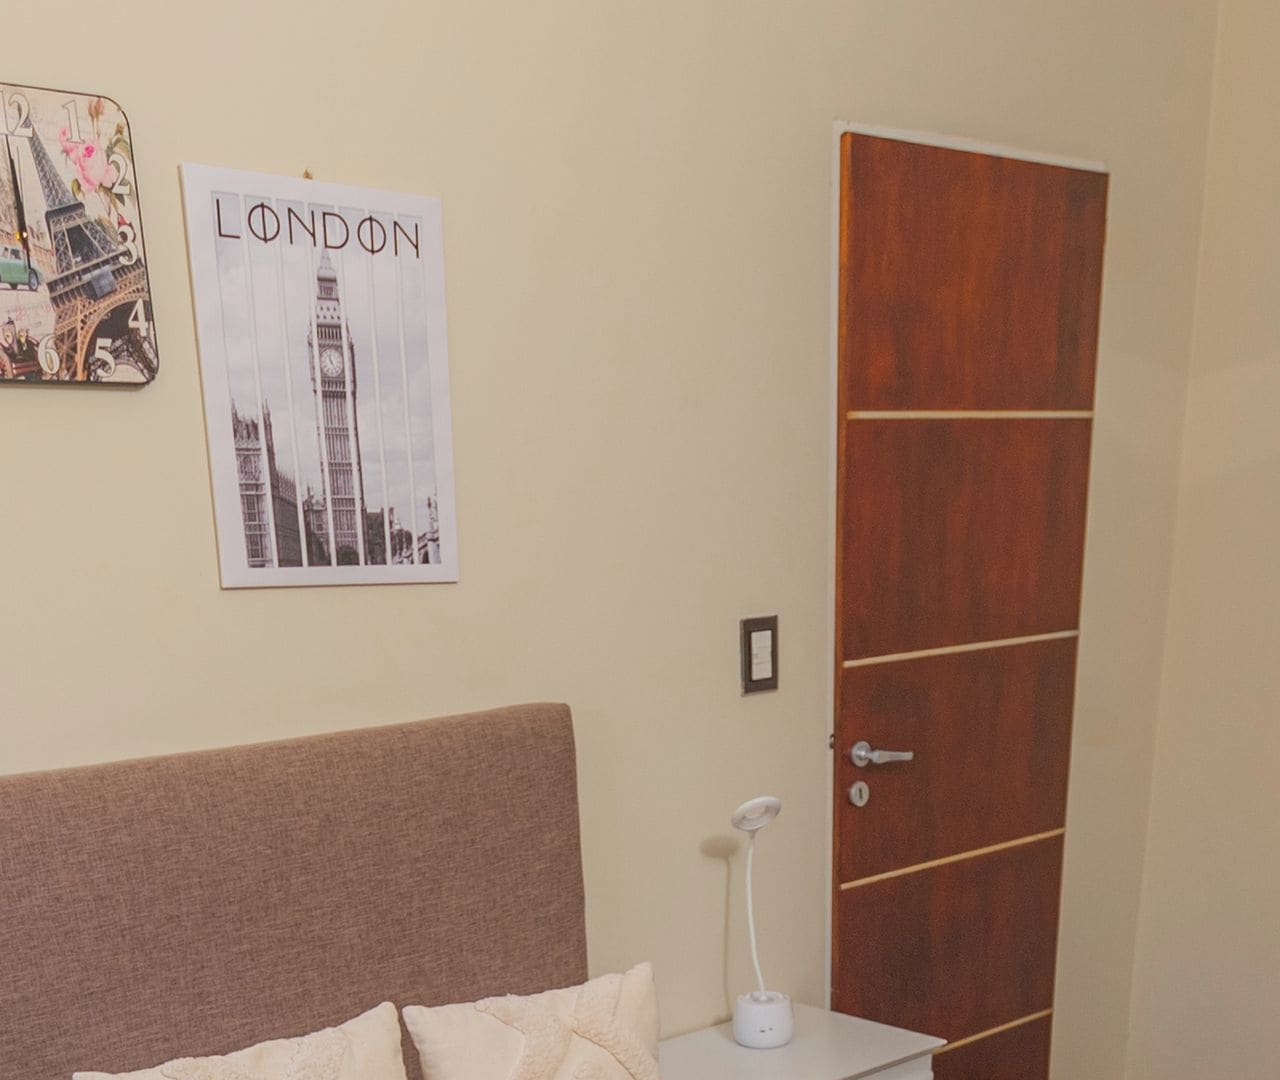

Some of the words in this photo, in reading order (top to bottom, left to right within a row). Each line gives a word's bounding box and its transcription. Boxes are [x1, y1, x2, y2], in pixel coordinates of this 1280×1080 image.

[61, 99, 86, 145] 1
[107, 154, 132, 195] 2
[117, 225, 138, 266] 3
[216, 198, 420, 259] LONDON
[127, 297, 150, 337] 4
[37, 333, 61, 376] 6
[92, 337, 116, 379] 5
